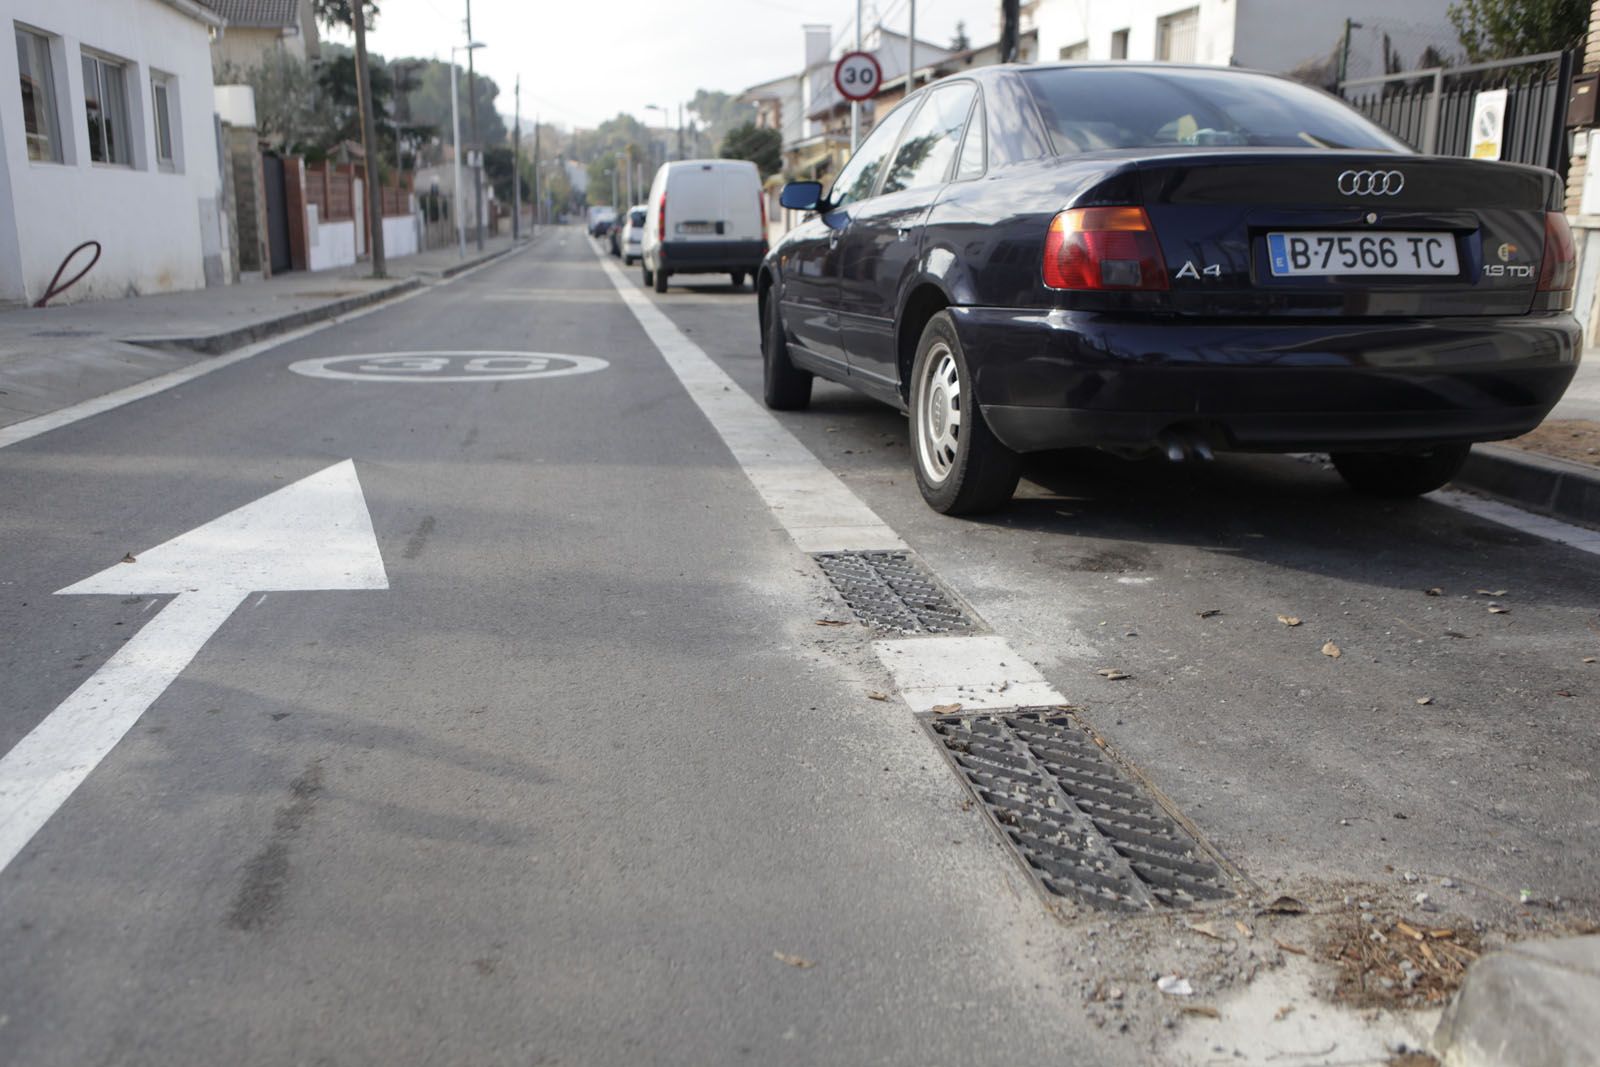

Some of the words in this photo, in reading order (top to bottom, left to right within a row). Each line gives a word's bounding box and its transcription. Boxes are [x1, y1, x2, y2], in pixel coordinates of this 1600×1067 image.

[845, 67, 873, 84] 30
[1407, 238, 1445, 269] TC
[1175, 260, 1221, 279] A4
[1506, 265, 1536, 277] TDI
[359, 356, 550, 372] 30
